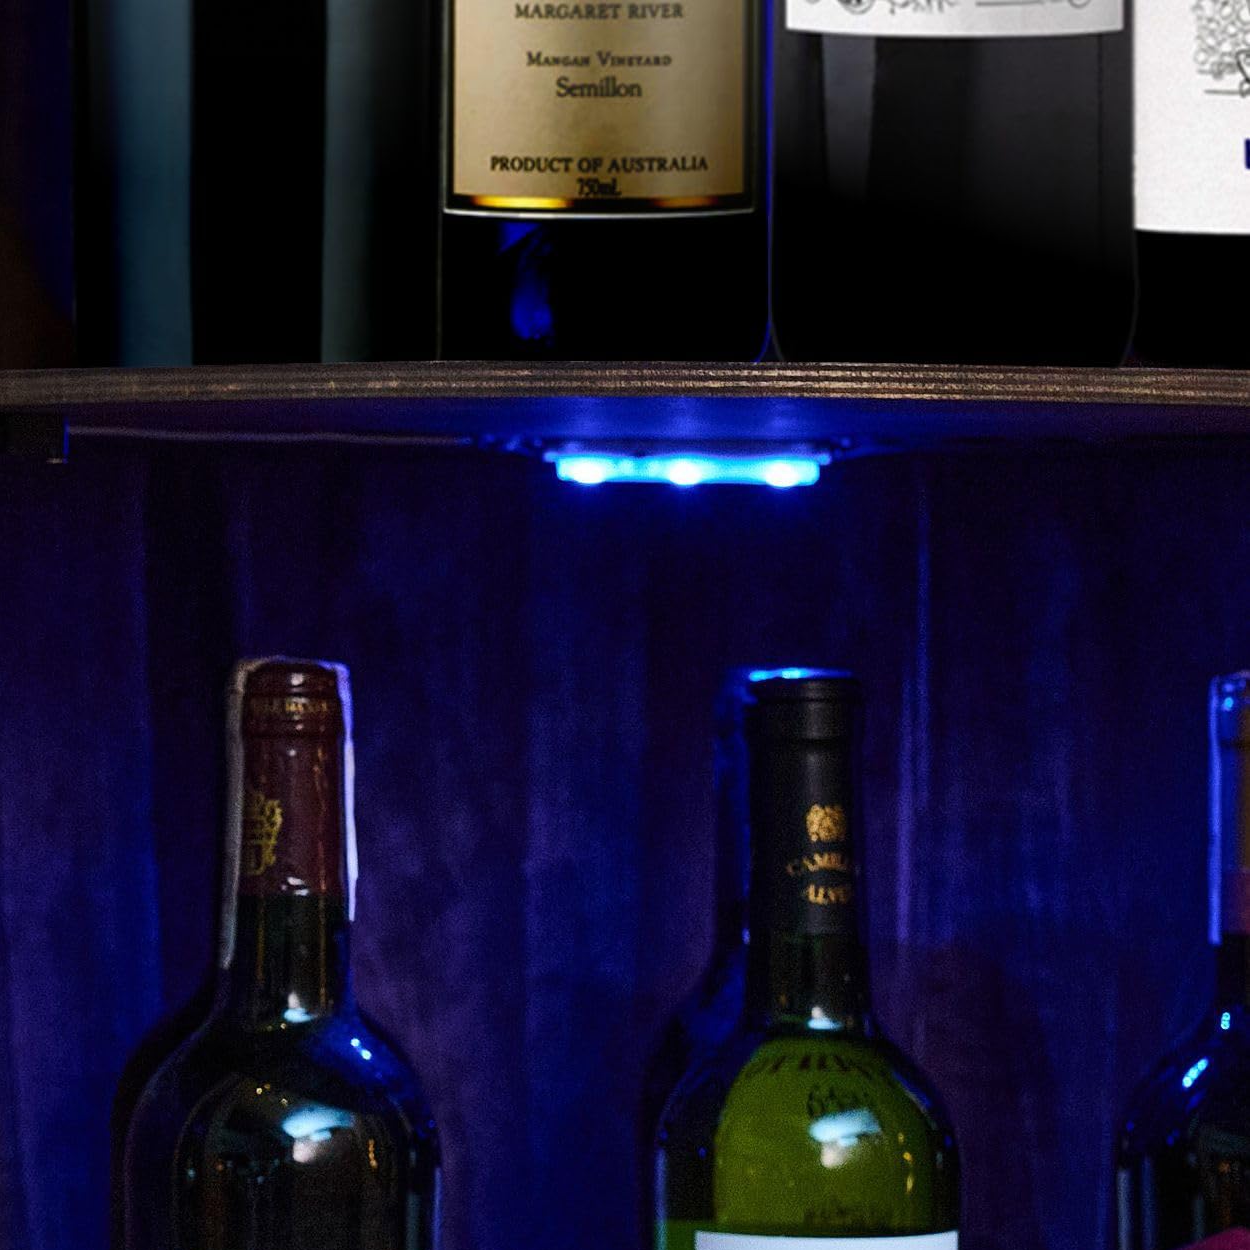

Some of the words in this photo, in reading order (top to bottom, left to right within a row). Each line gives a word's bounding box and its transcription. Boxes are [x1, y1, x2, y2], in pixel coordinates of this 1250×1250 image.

[514, 3, 622, 19] MARGARET
[628, 3, 684, 19] RIVER
[555, 76, 643, 98] Semillon
[490, 156, 573, 172] PRODUCT
[576, 156, 603, 173] OF
[607, 156, 709, 172] AUSTRALIA
